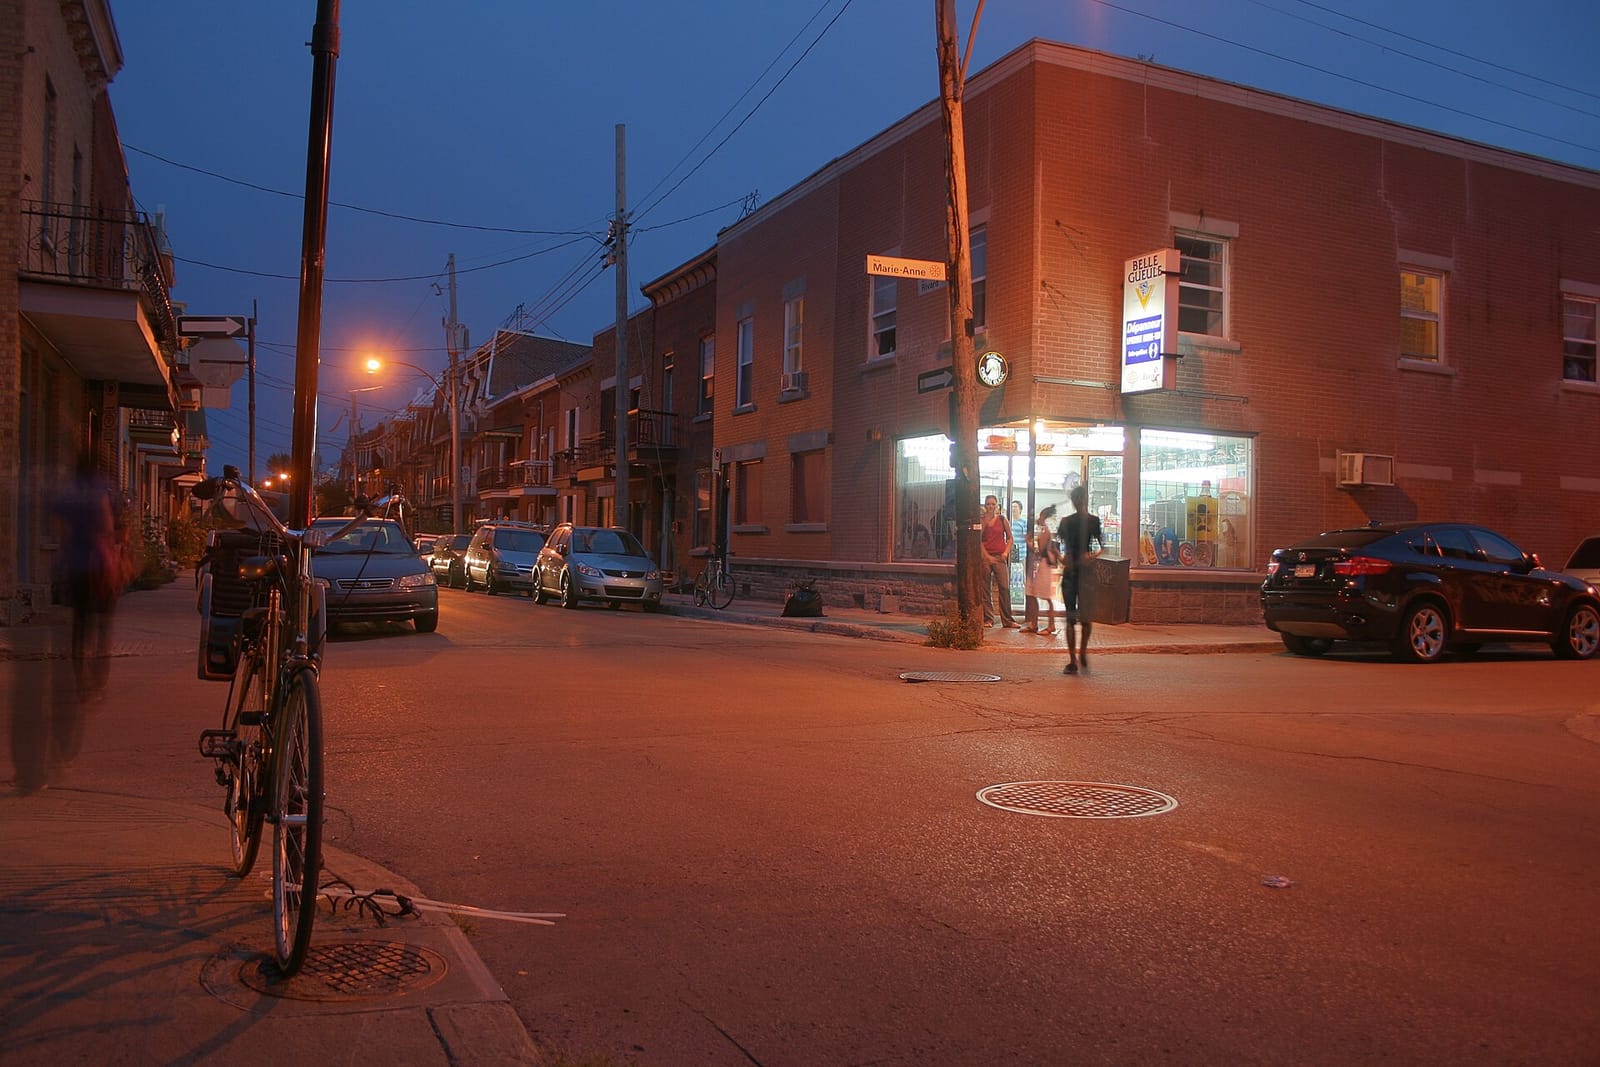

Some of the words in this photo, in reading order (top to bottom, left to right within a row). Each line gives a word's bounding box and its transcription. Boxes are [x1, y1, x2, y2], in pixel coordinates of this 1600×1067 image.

[873, 263, 926, 276] Marie-Anne
[1132, 255, 1159, 271] BELLE
[1128, 265, 1162, 283] GUEULE
